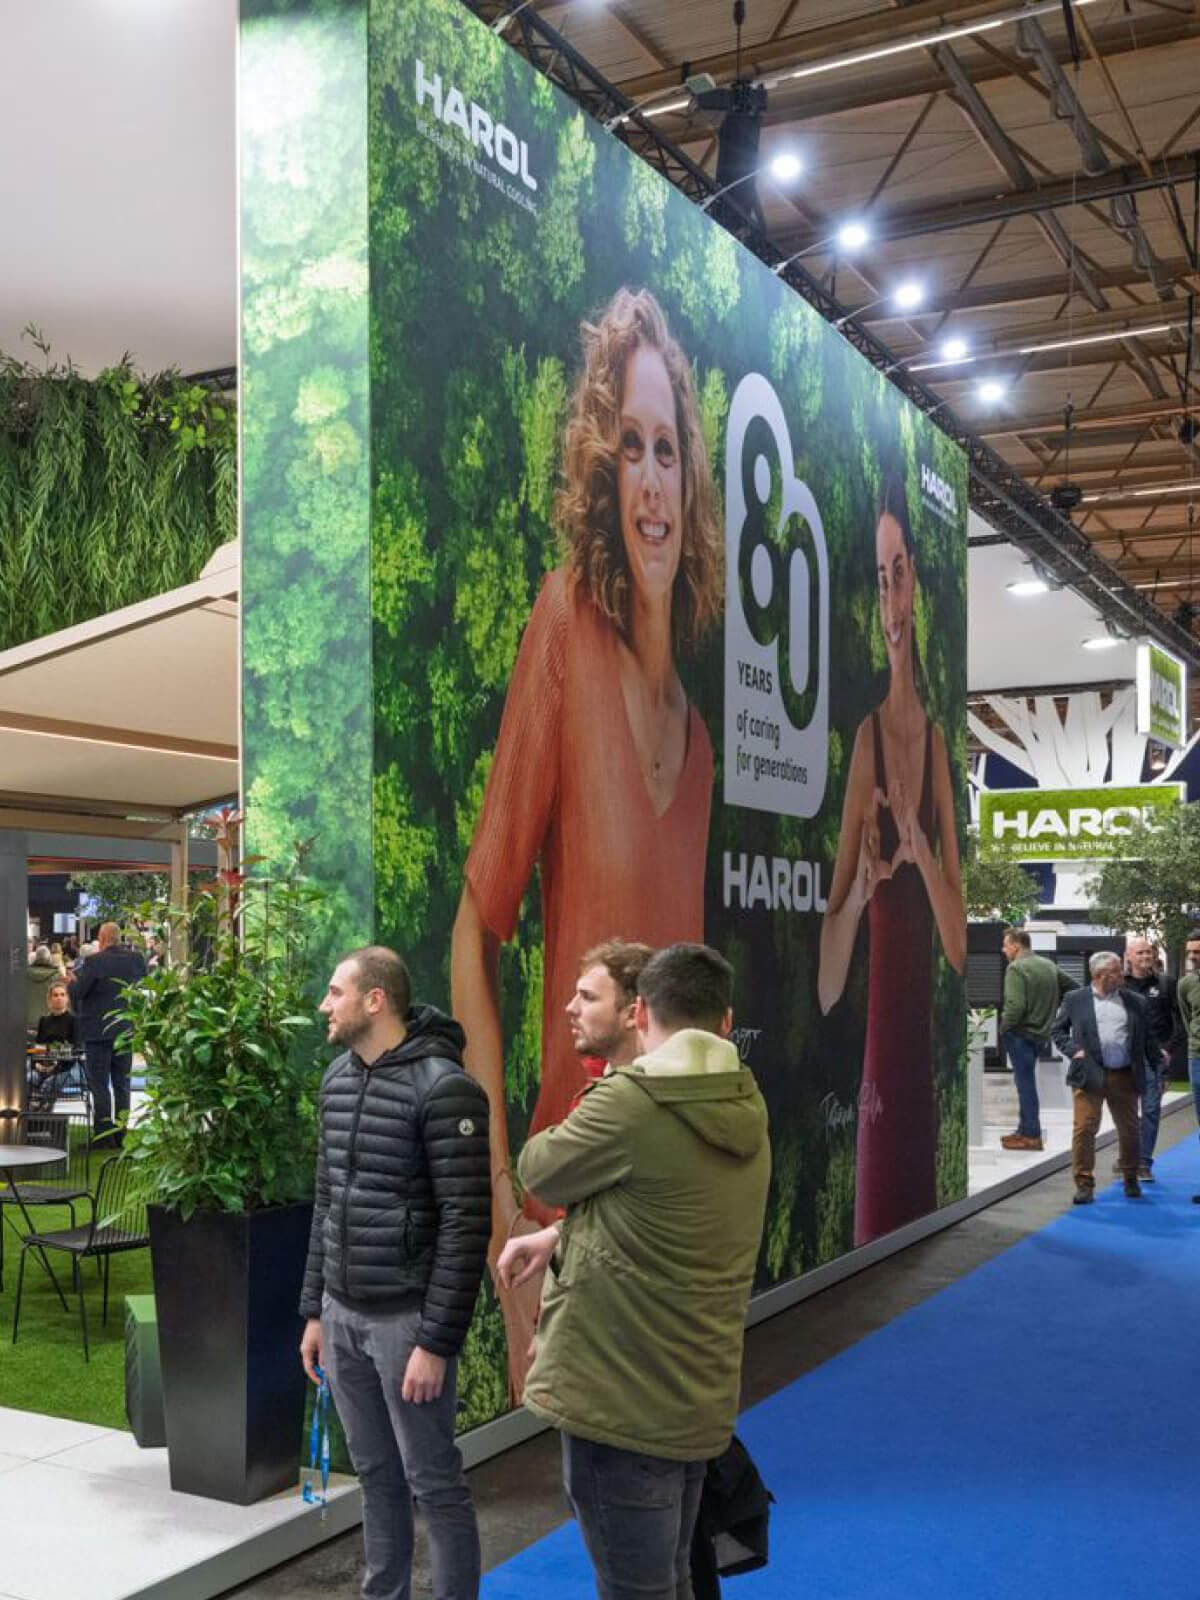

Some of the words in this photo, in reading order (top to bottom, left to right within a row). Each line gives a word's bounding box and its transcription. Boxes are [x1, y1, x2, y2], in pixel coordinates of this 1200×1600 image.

[415, 58, 538, 192] HAROL
[921, 463, 958, 515] HAROL
[737, 659, 773, 696] YEARS
[737, 709, 749, 740] of
[750, 715, 780, 751] caring
[737, 744, 751, 777] for
[754, 755, 808, 785] generations
[723, 851, 828, 913] HAROL
